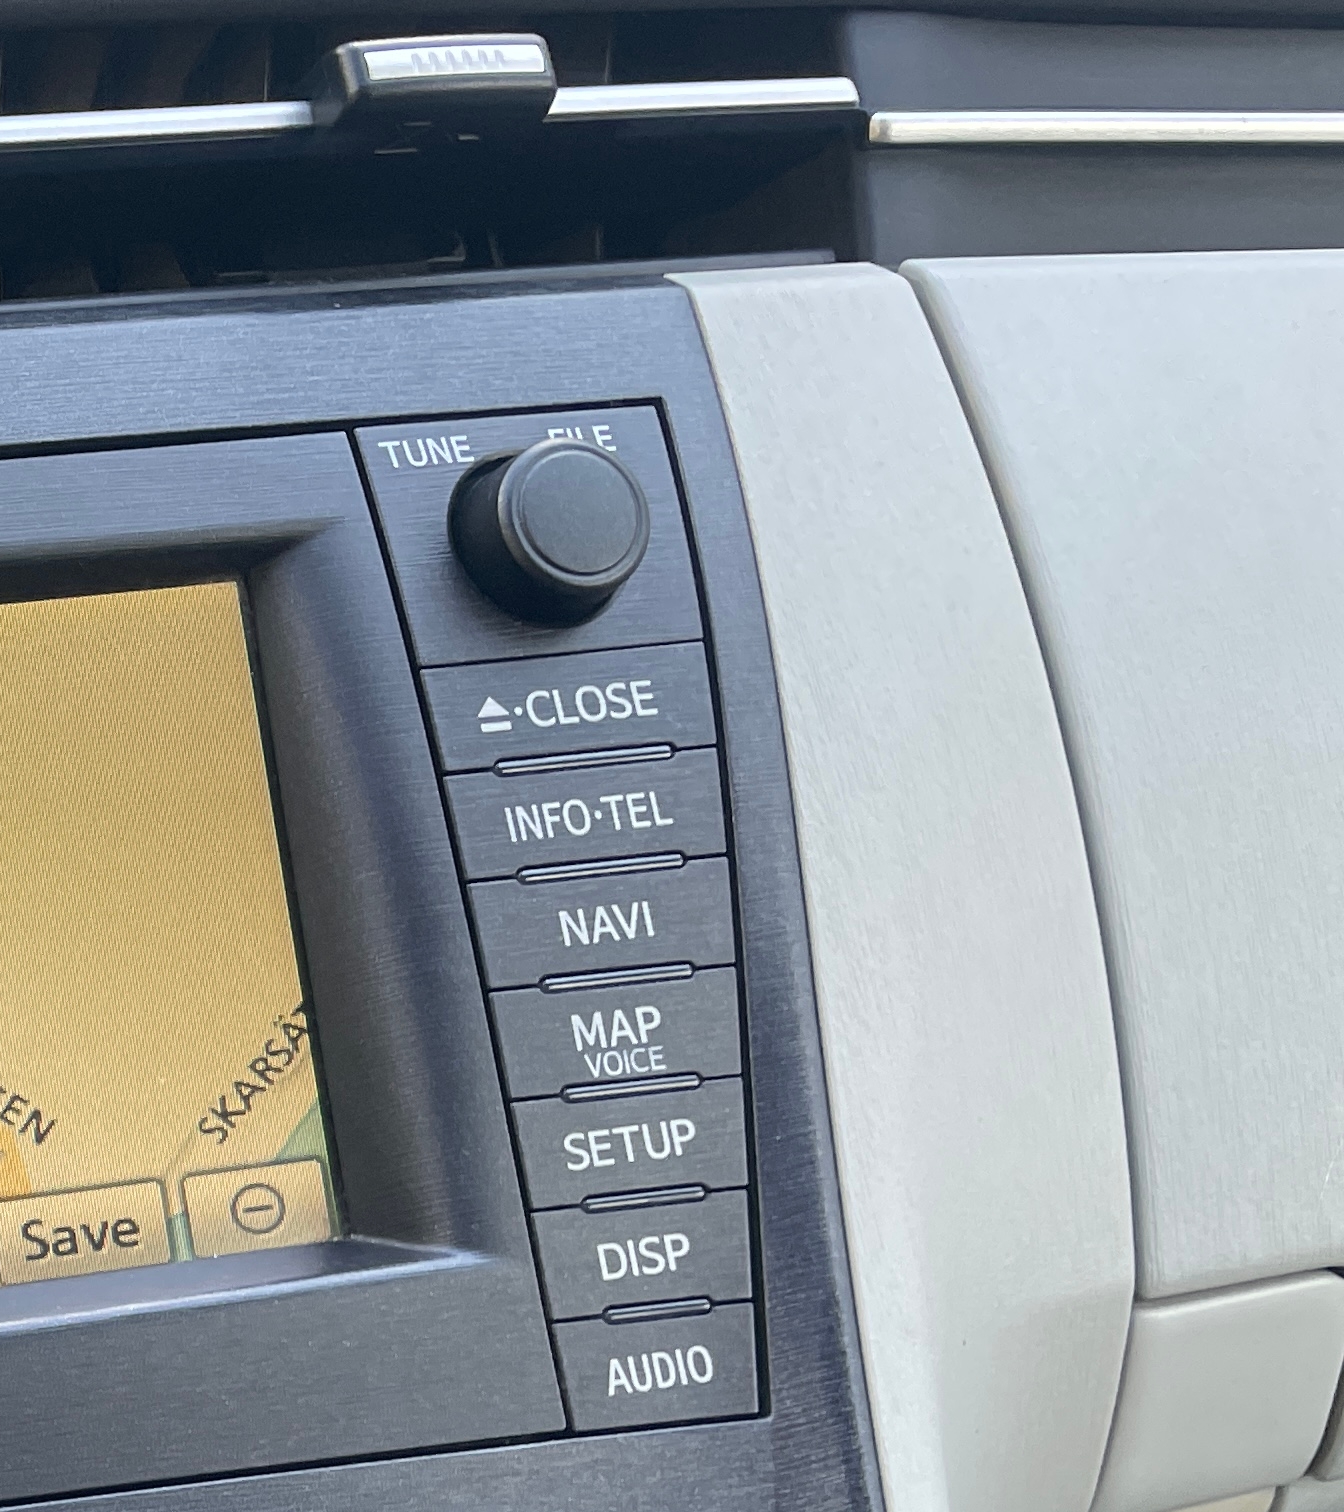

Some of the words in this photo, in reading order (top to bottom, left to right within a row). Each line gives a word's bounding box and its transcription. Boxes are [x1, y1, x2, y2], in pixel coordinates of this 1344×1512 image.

[377, 434, 475, 469] TUNE
[558, 900, 655, 947] NAVI
[569, 1005, 663, 1052] MAP
[584, 1044, 668, 1078] VOICE
[563, 1118, 696, 1171] SETUP
[21, 1217, 140, 1262] Save
[596, 1233, 690, 1281] DISP
[608, 1345, 714, 1397] AUDIO
